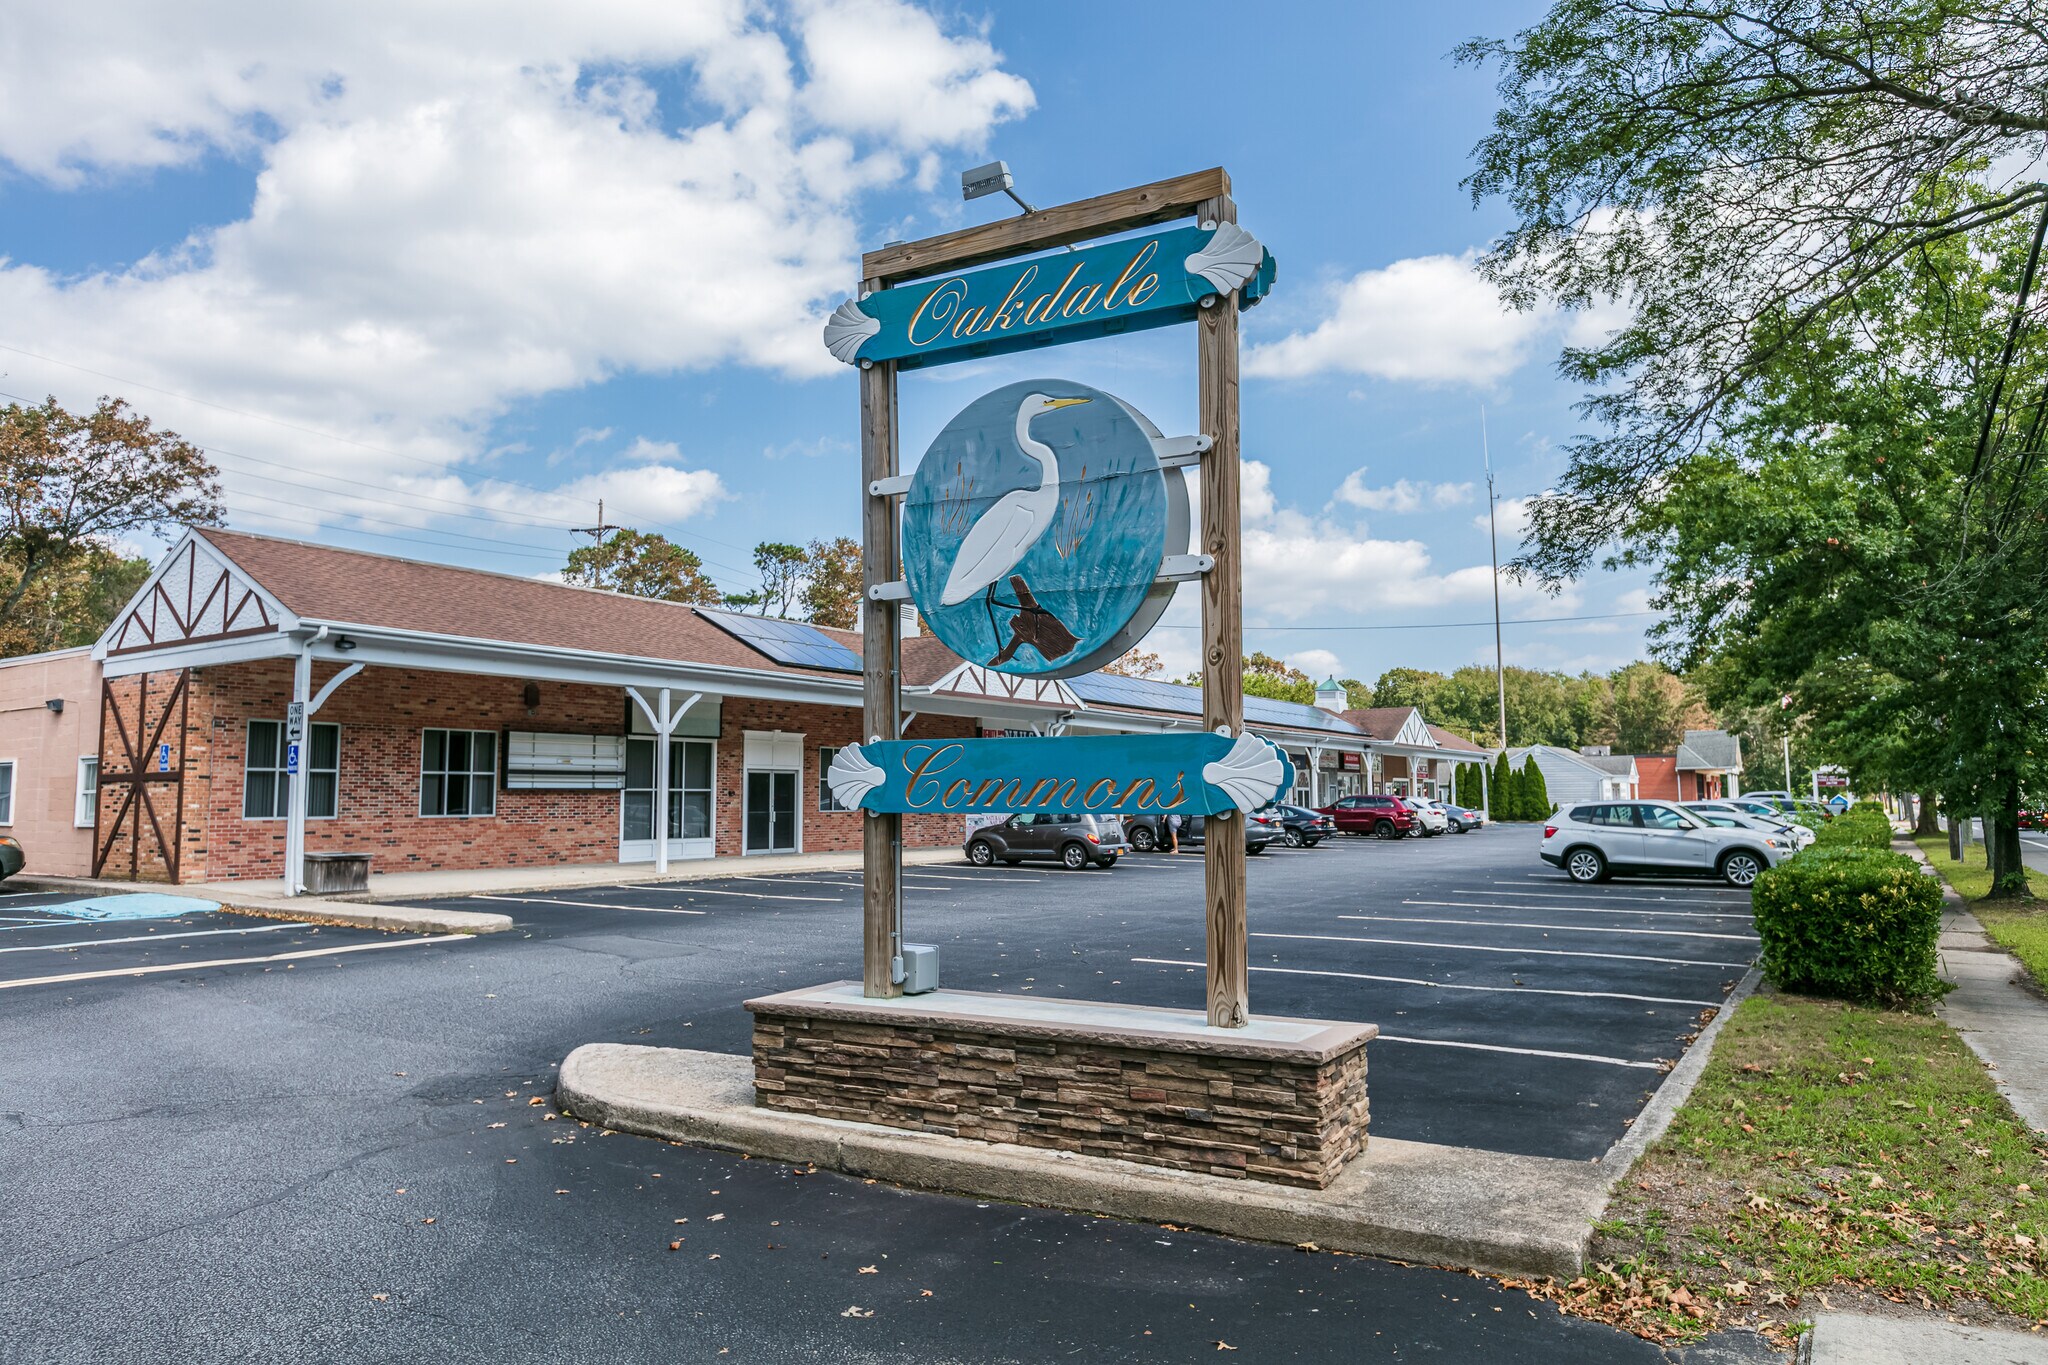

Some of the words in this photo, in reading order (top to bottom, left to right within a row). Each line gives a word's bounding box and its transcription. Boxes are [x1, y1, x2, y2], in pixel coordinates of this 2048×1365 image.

[907, 239, 1159, 346] Oakdale
[289, 705, 302, 715] ONE
[289, 715, 302, 725] WAY
[901, 743, 1190, 809] Commons
